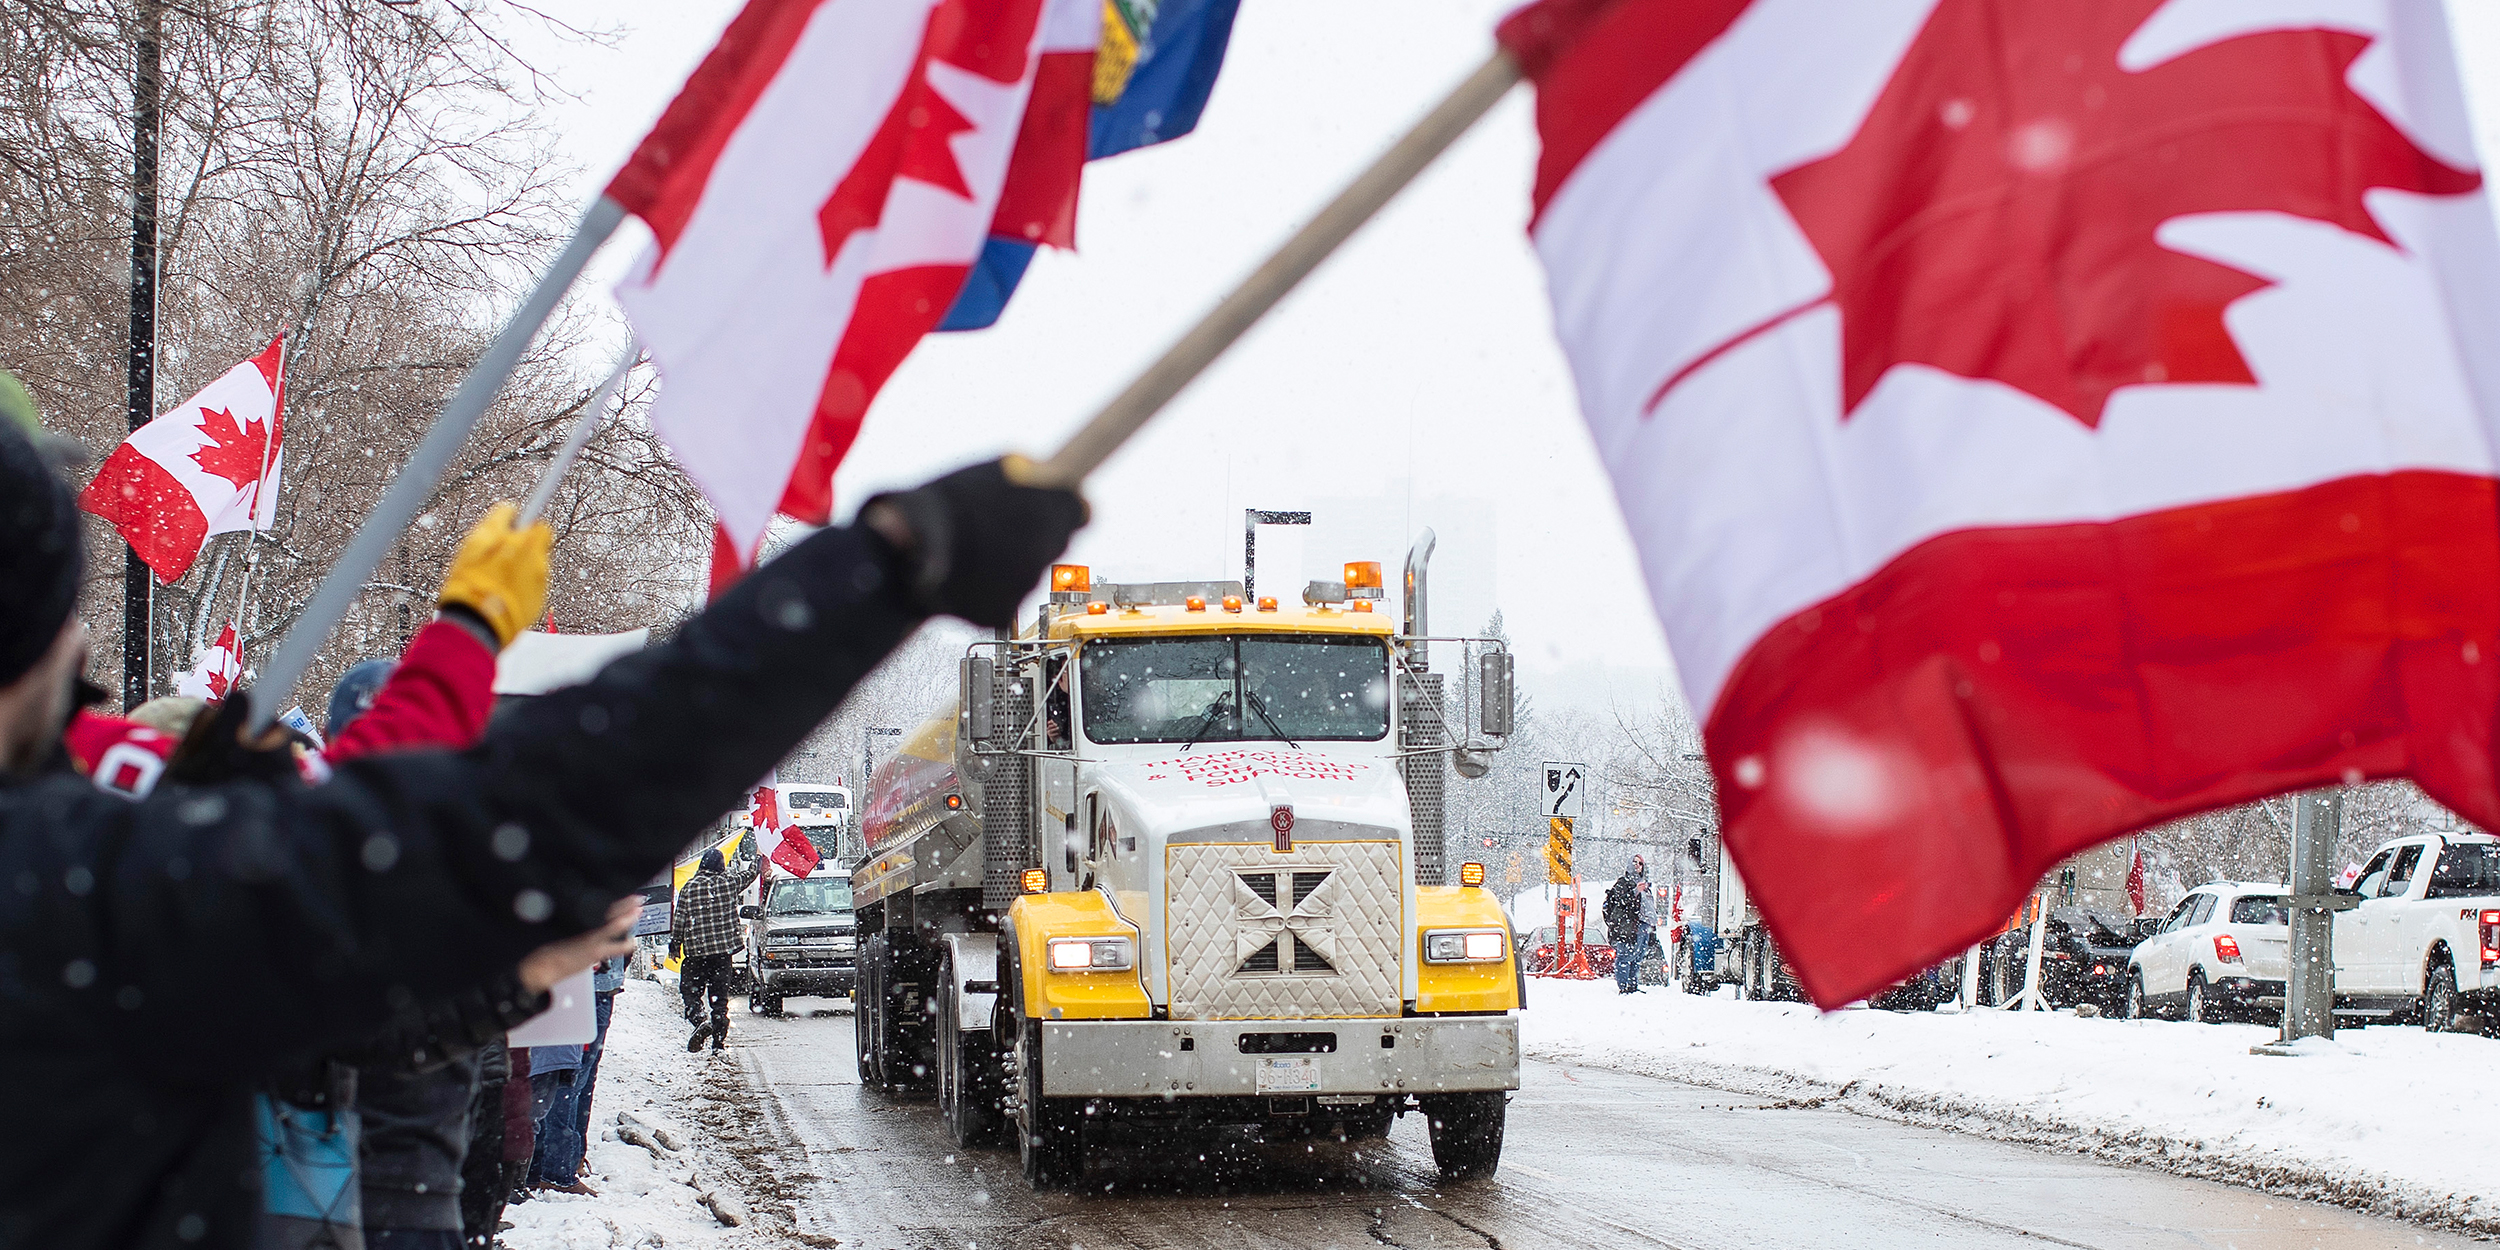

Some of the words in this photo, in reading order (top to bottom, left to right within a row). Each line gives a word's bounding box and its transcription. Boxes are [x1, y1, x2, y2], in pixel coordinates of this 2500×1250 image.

[1140, 750, 1249, 767] THANK
[1177, 762, 1242, 775] THE
[1252, 756, 1369, 769] WORLD
[1179, 753, 1312, 768] CANADA
[1187, 764, 1252, 782] FOR
[1264, 761, 1354, 774] YOUR
[1207, 768, 1358, 787] SUPPORT
